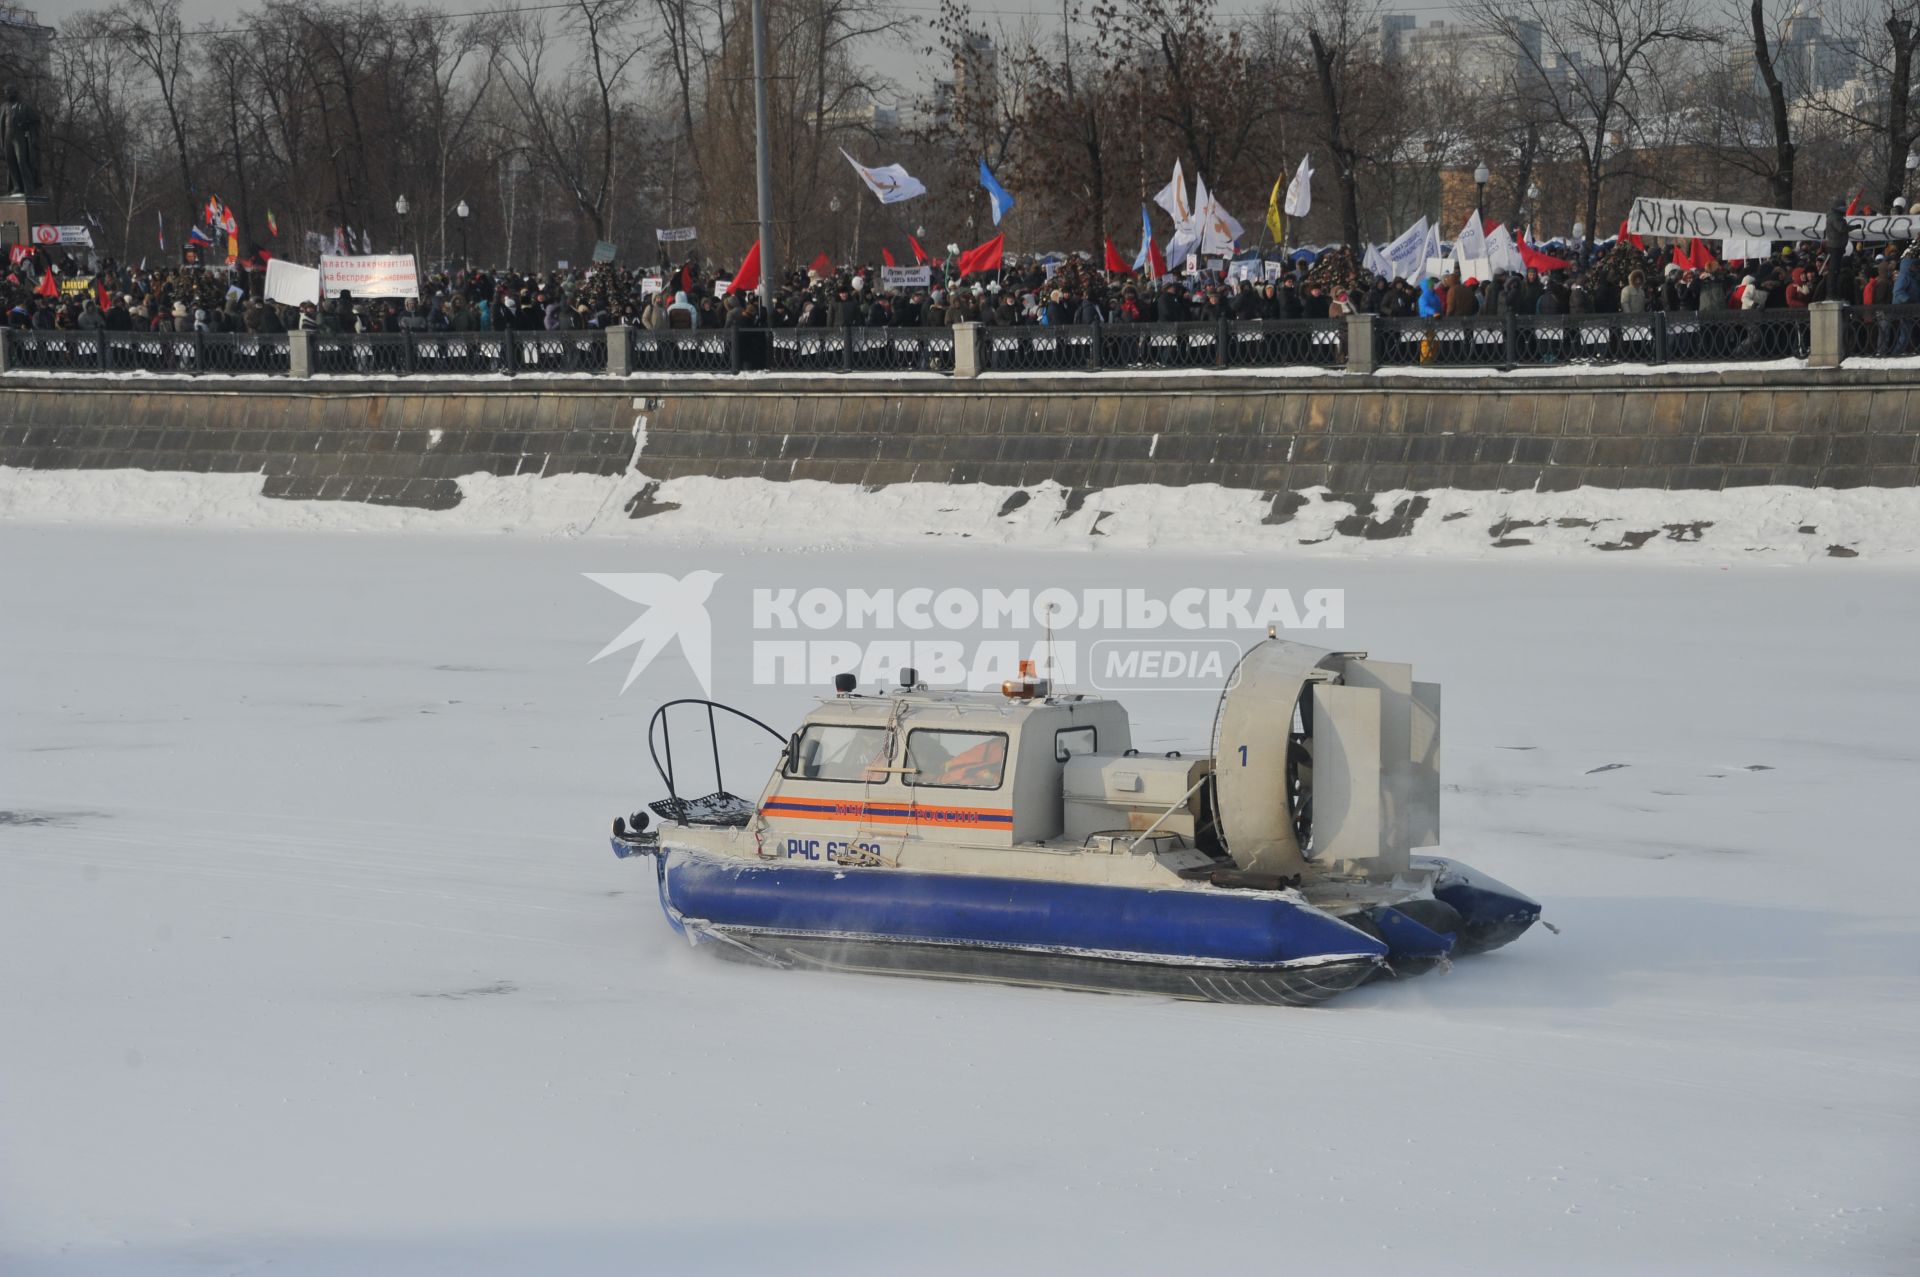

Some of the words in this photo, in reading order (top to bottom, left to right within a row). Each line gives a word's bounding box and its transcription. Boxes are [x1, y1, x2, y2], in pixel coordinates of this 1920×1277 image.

[1238, 745, 1247, 767] 1
[915, 809, 978, 823] РОССИИ
[787, 839, 820, 861] РЧС
